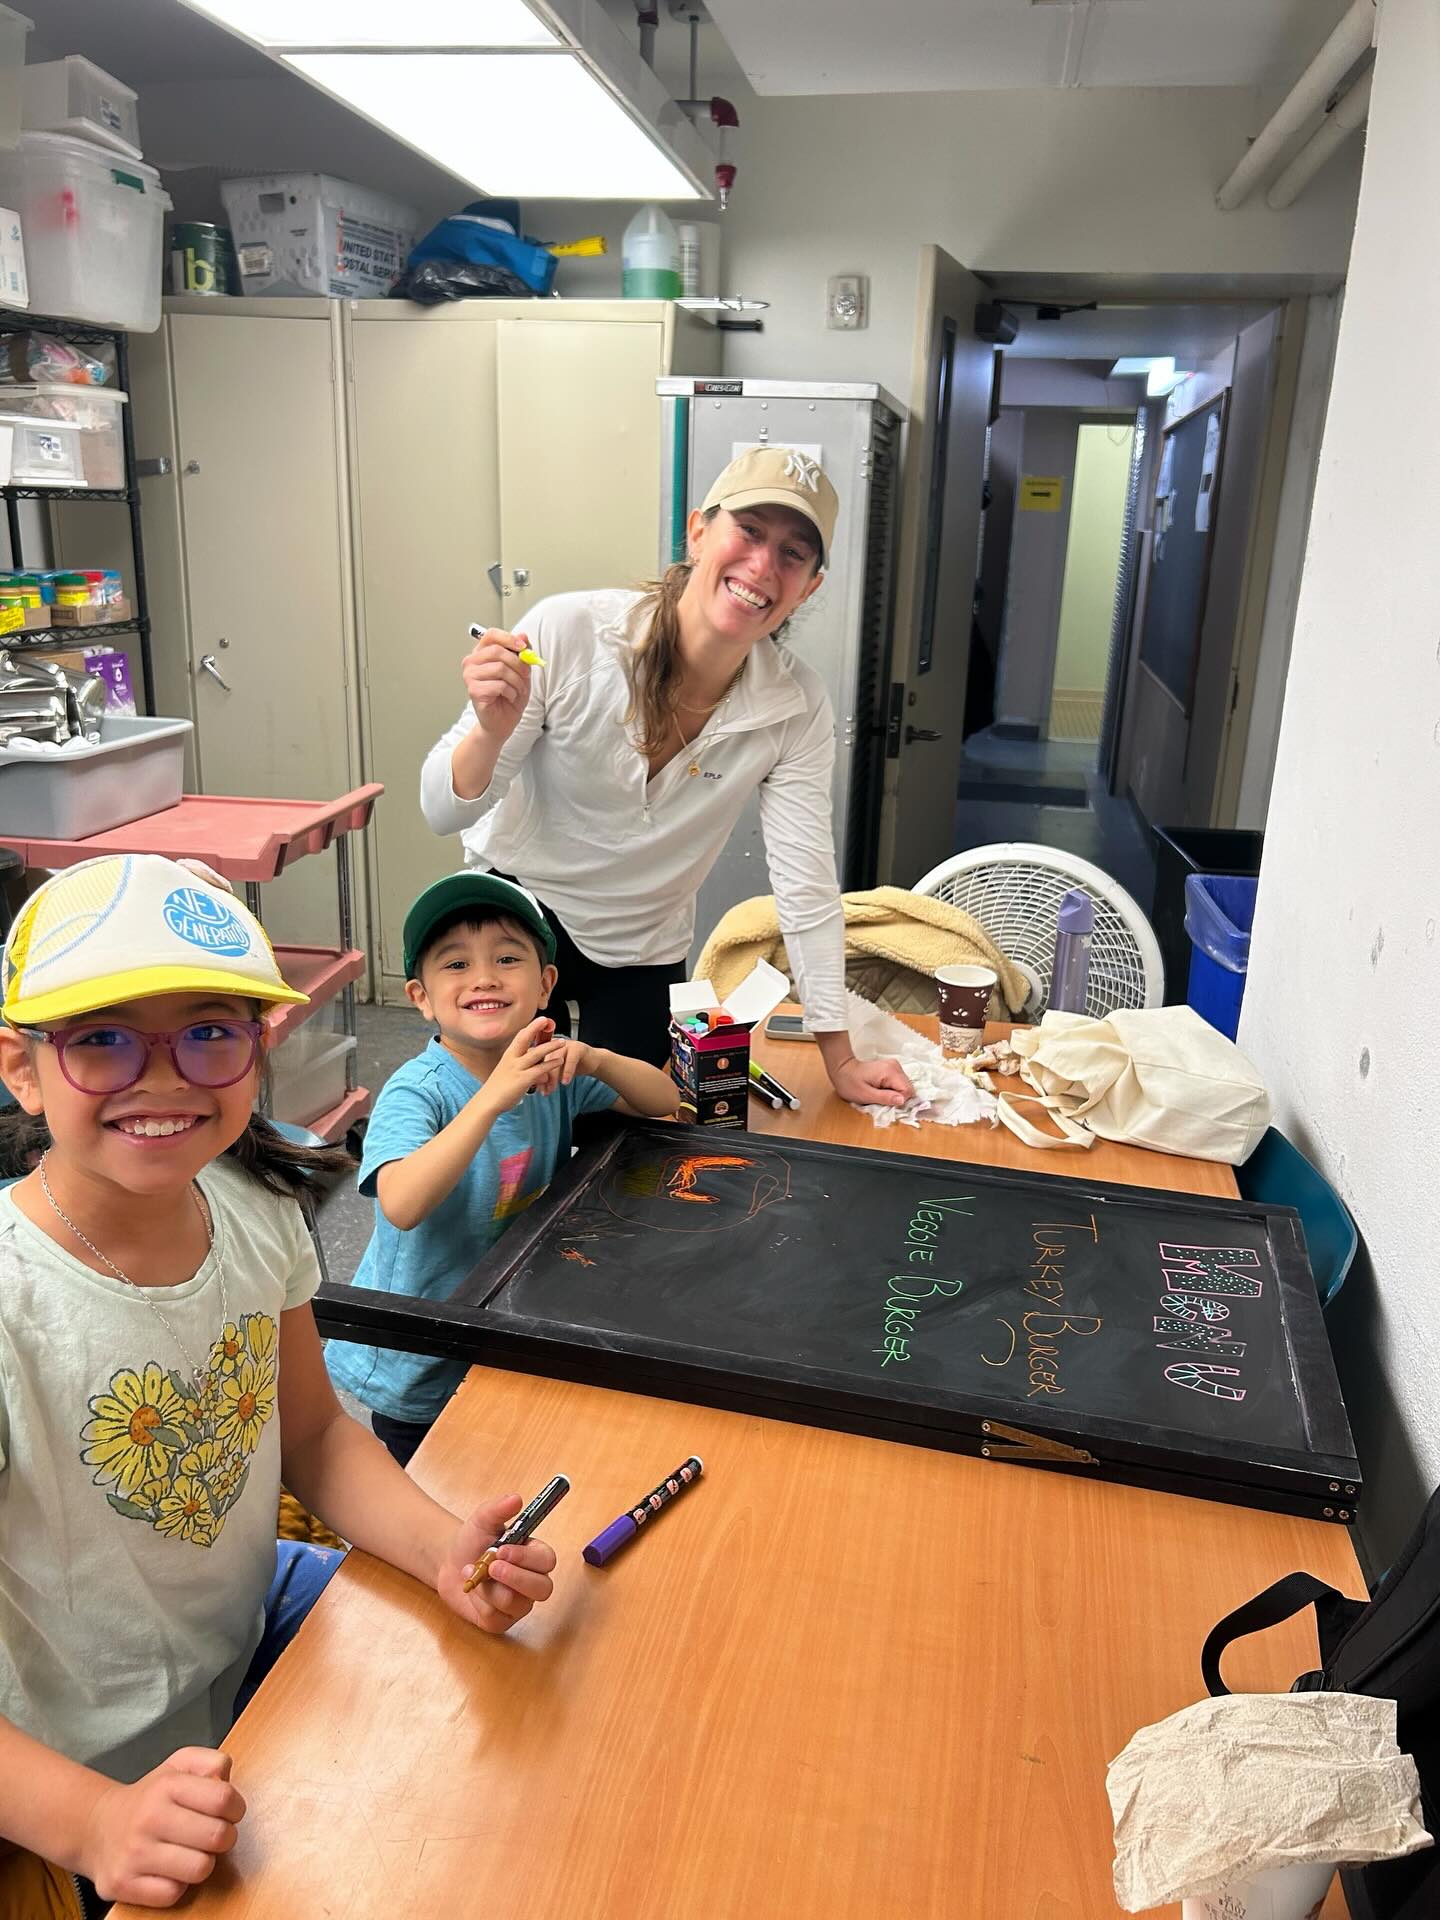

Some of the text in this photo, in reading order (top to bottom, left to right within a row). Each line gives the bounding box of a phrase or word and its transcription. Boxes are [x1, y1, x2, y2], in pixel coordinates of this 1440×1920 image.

[340, 257, 370, 275] OSTAL
[783, 454, 820, 492] NY
[172, 888, 224, 920] NET
[872, 1196, 976, 1367] VEGGIE BURGER
[1022, 1214, 1104, 1397] TURKEY BURGER
